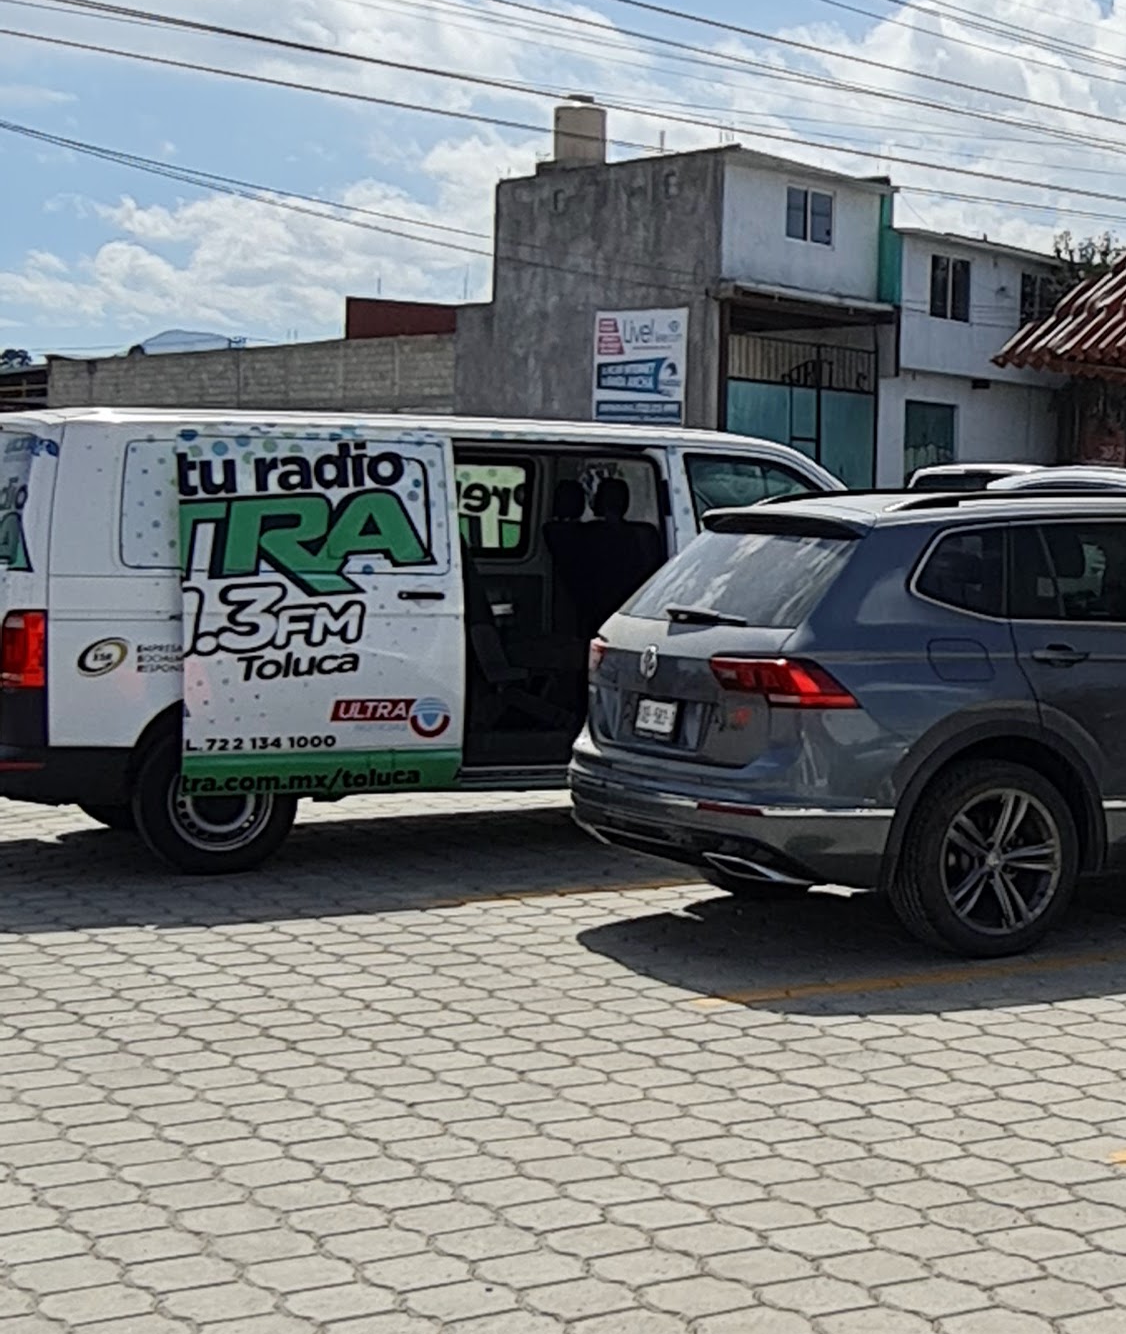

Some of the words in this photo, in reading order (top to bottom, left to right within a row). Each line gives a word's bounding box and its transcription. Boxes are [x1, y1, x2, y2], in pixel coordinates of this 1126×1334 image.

[177, 451, 238, 497] tu
[253, 441, 405, 493] radio
[237, 652, 360, 681] Toluca
[338, 702, 407, 718] ULTRA
[249, 736, 282, 750] 134
[287, 734, 336, 749] 1000
